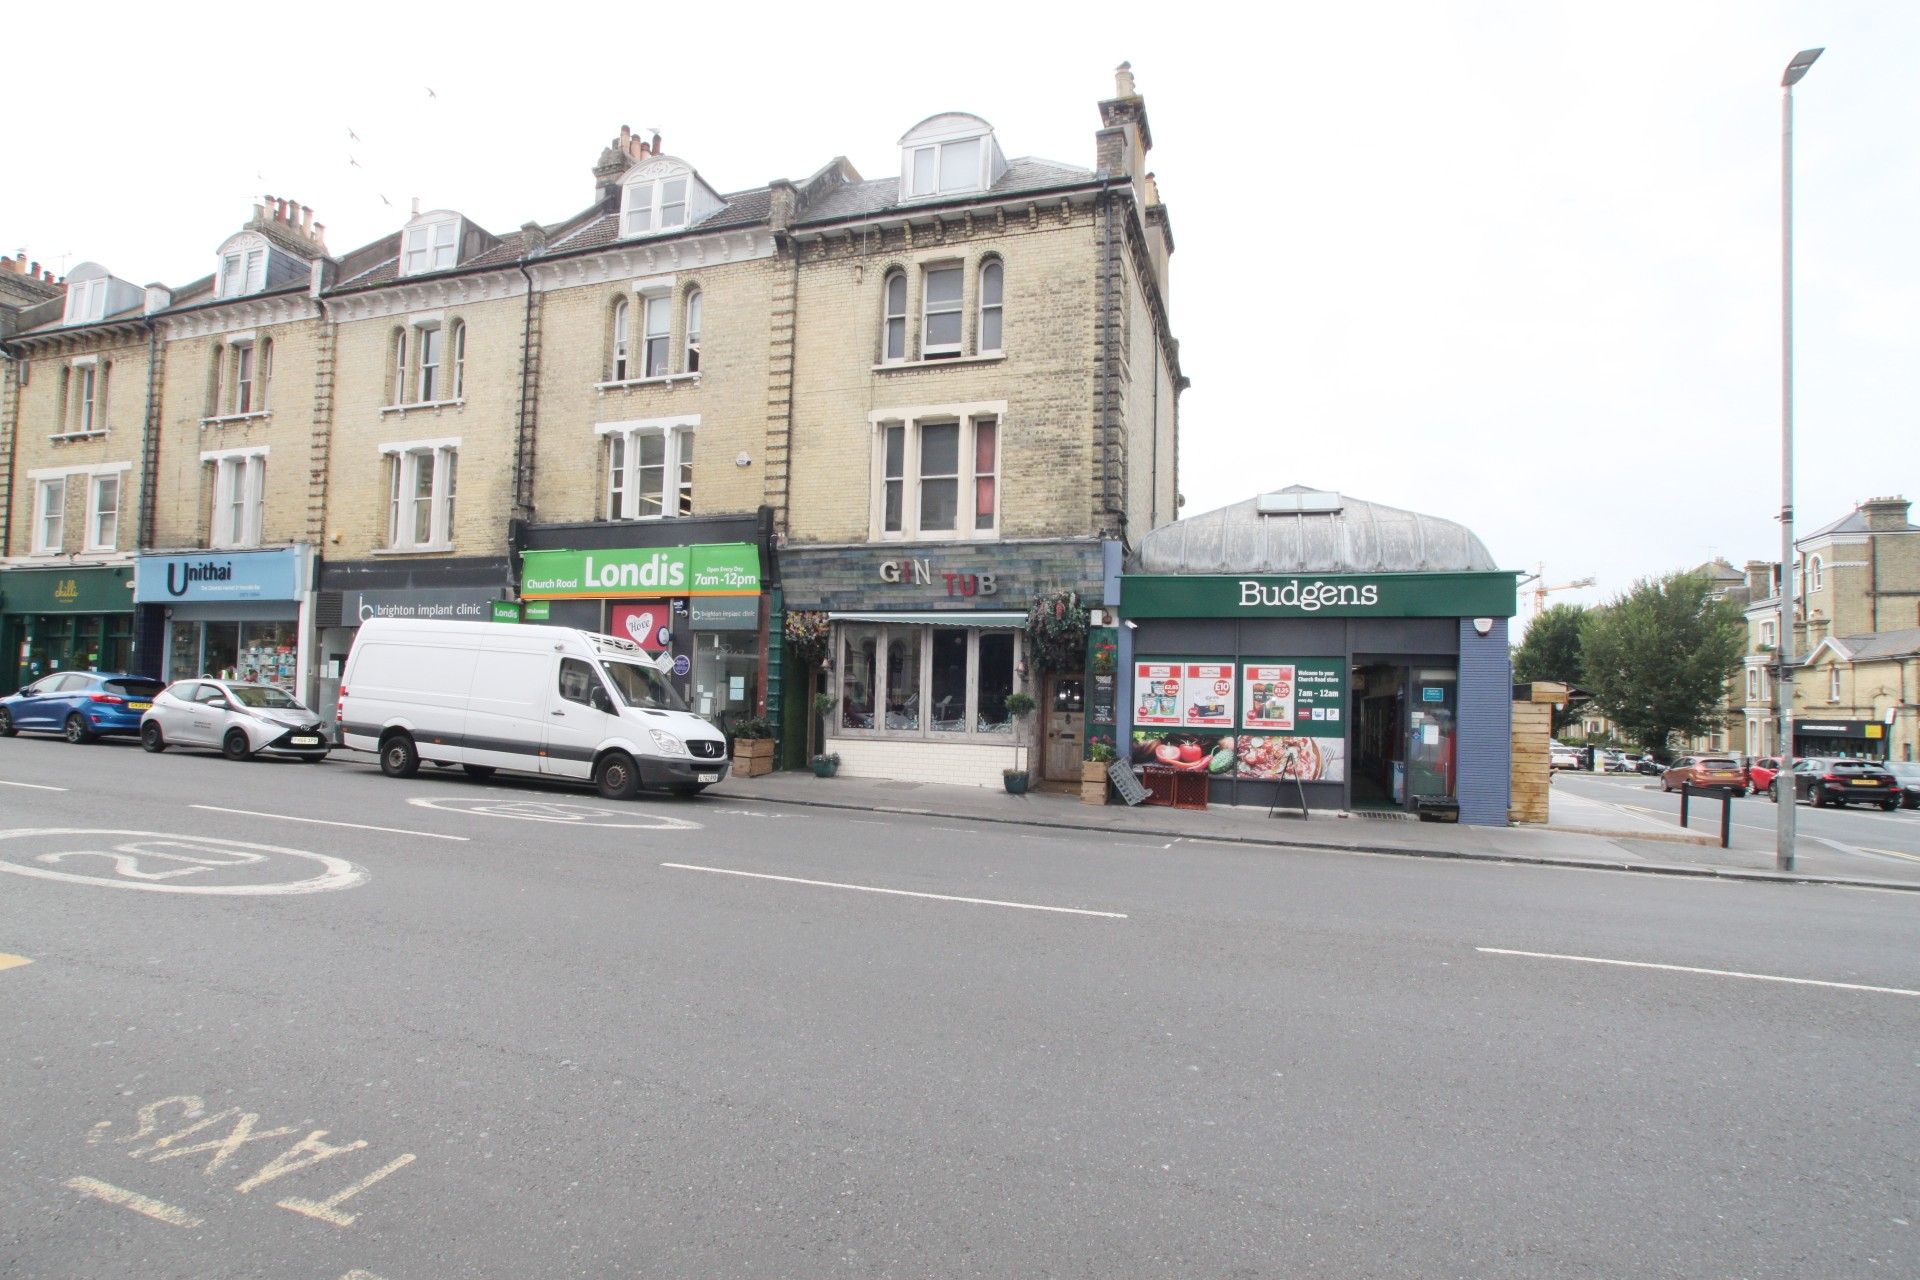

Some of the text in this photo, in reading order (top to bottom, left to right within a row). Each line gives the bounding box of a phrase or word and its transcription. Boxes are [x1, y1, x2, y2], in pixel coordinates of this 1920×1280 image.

[584, 553, 685, 587] Londis
[167, 561, 232, 597] Unithai
[527, 579, 577, 589] Church Road
[694, 573, 719, 585] 7am
[880, 558, 998, 597] GIN TUB
[1238, 579, 1379, 611] Budgens
[377, 603, 481, 617] brighton implant clinic
[495, 607, 518, 618] Londis
[1215, 682, 1229, 691] £10
[1298, 689, 1313, 697] 7am
[1320, 689, 1339, 698] 12am
[35, 840, 270, 881] 20
